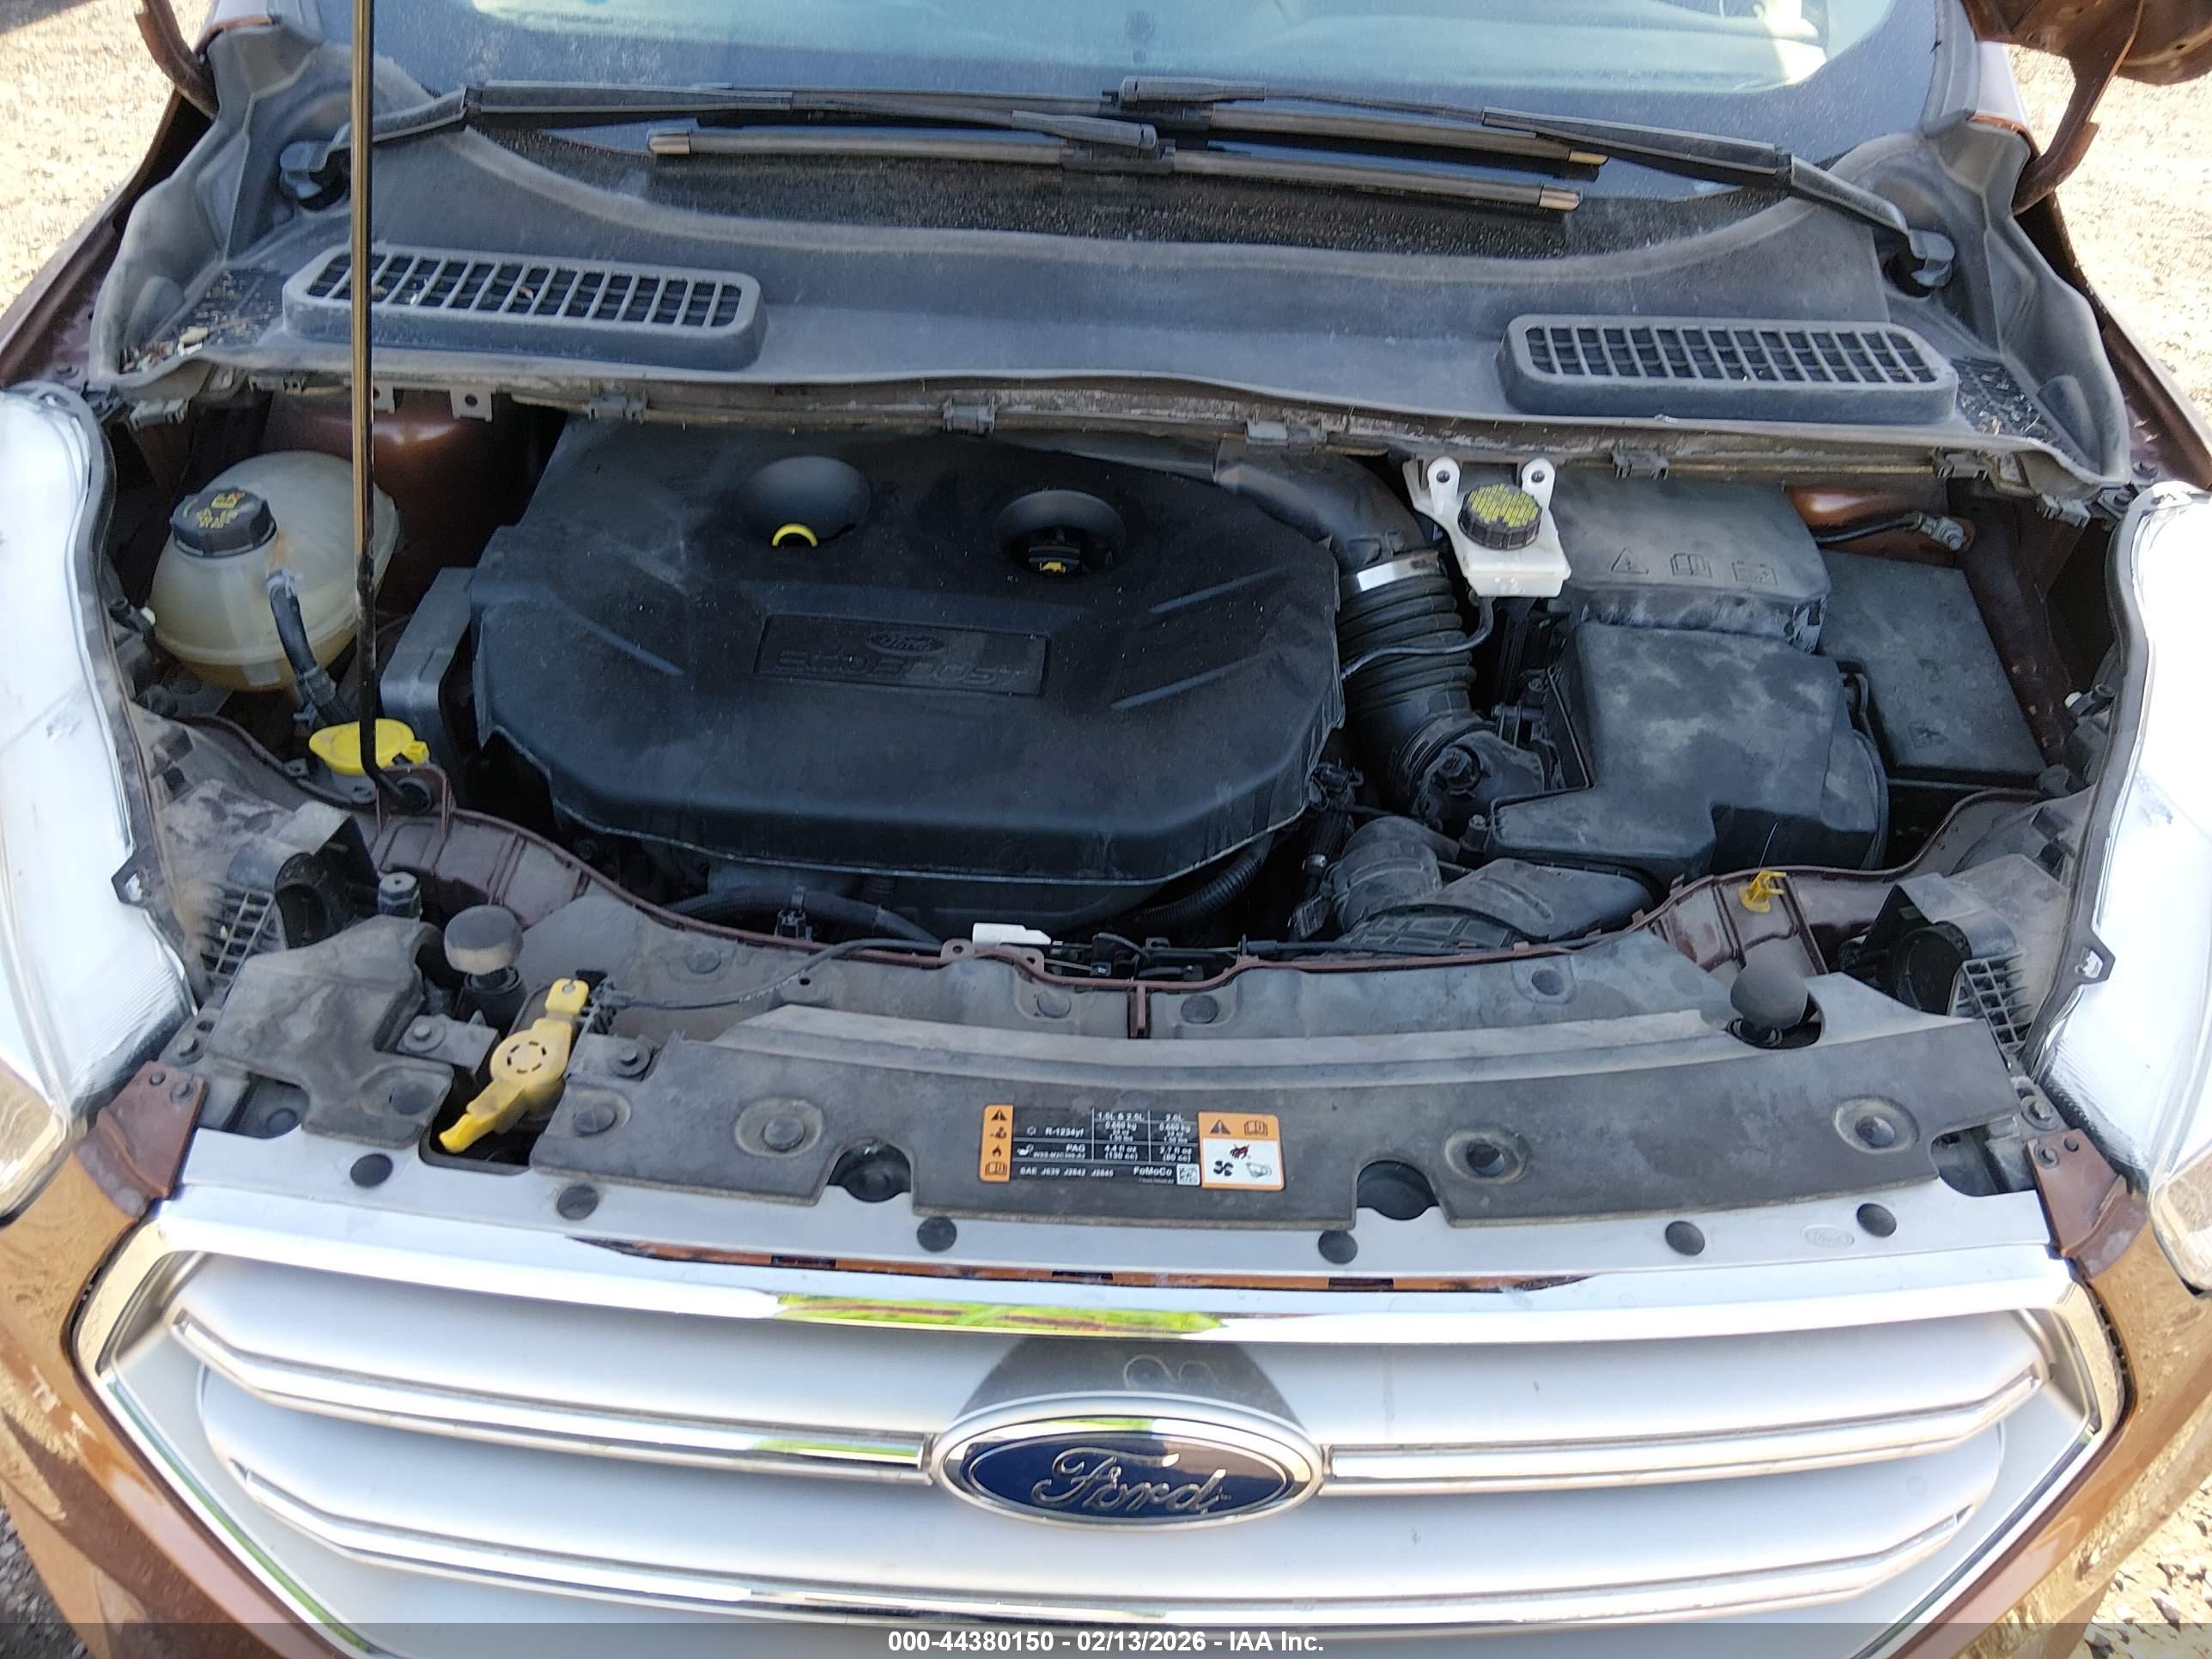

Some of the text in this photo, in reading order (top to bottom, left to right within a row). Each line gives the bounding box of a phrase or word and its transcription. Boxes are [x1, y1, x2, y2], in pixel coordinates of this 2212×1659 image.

[1045, 1126, 1085, 1138] R-1234yf
[1127, 1121, 1138, 1132] kg
[1181, 1122, 1192, 1133] kg
[1066, 1143, 1086, 1152] PAG
[1124, 1152, 1139, 1162] cc)
[1177, 1154, 1192, 1164] cc)
[1019, 1166, 1038, 1176] SAE
[1133, 1165, 1173, 1177] FoMoCo
[1031, 1446, 1228, 1516] Ford
